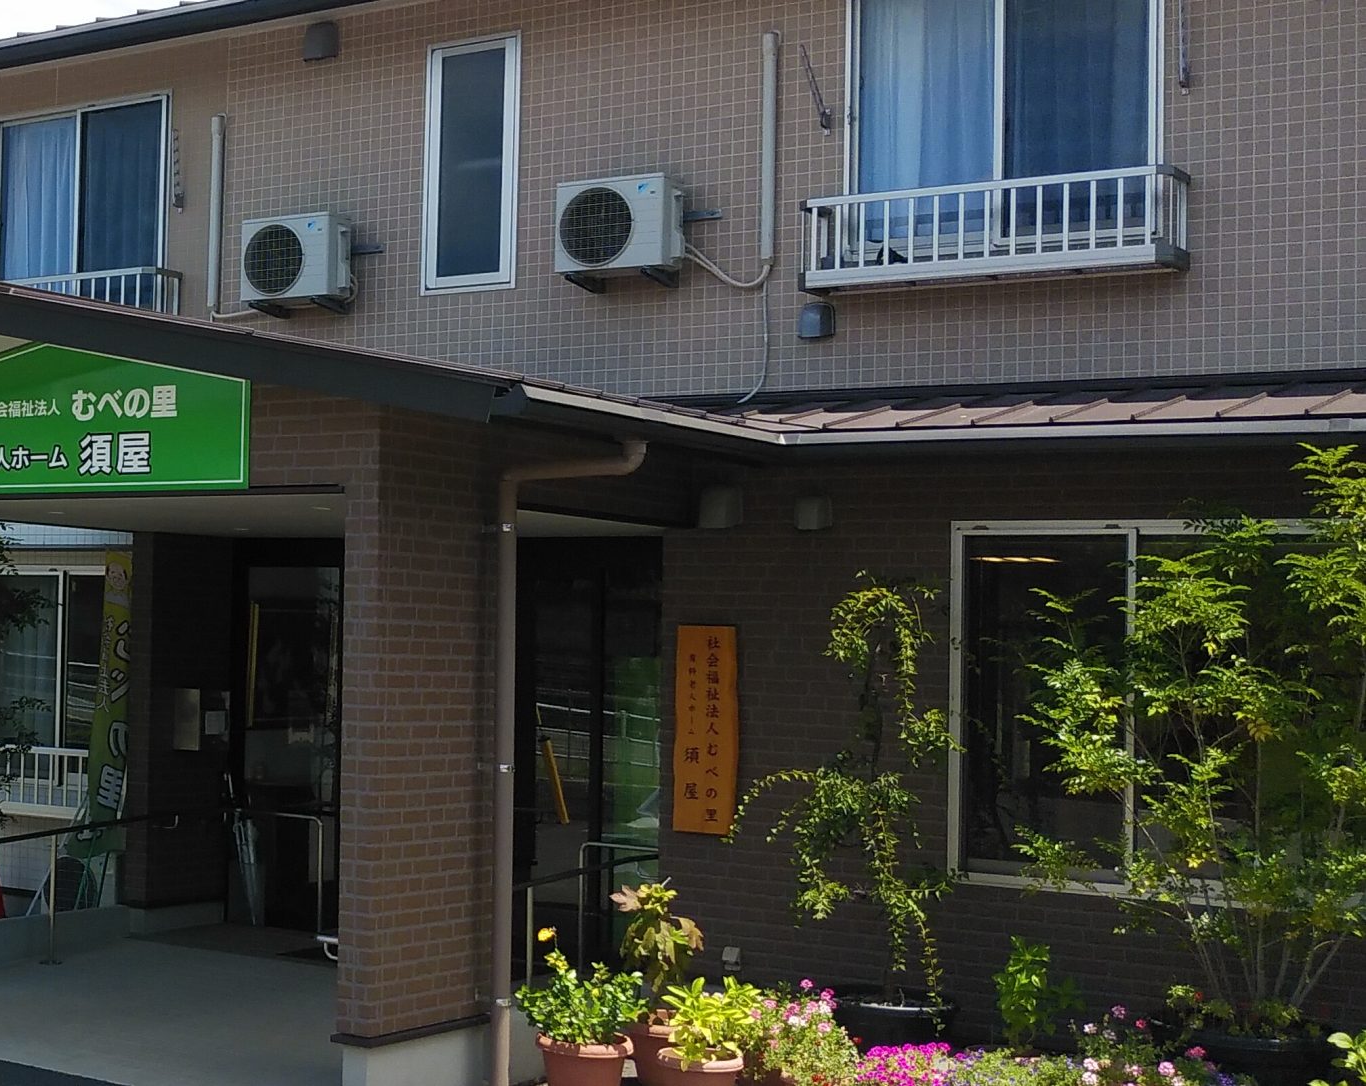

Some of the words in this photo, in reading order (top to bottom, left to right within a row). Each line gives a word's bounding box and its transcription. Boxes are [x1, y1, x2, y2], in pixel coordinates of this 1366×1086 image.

[71, 385, 178, 421] むべの里
[79, 432, 151, 475] 須屋
